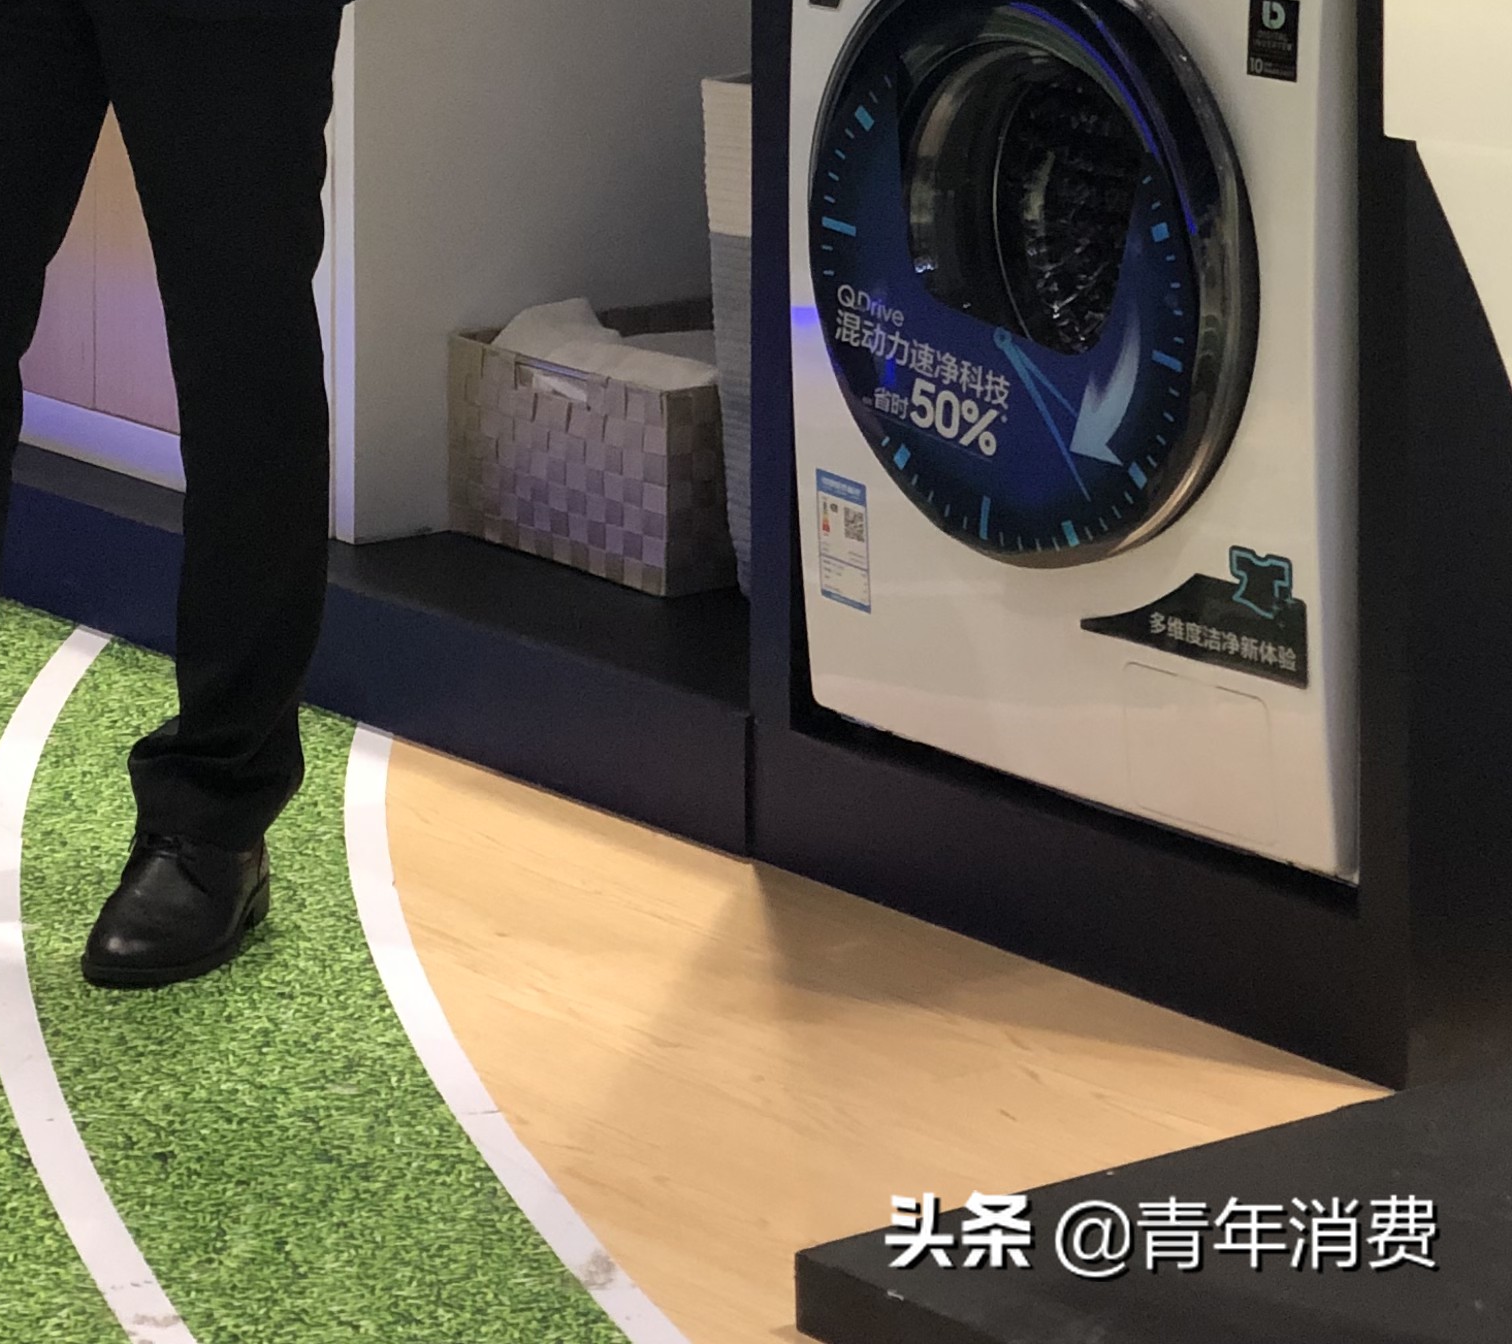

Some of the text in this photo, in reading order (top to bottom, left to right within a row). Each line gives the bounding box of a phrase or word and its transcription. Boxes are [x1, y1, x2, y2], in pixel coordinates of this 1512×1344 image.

[835, 311, 1011, 410] 混动力速净科技
[1149, 612, 1297, 672] 多维度洁净新体验
